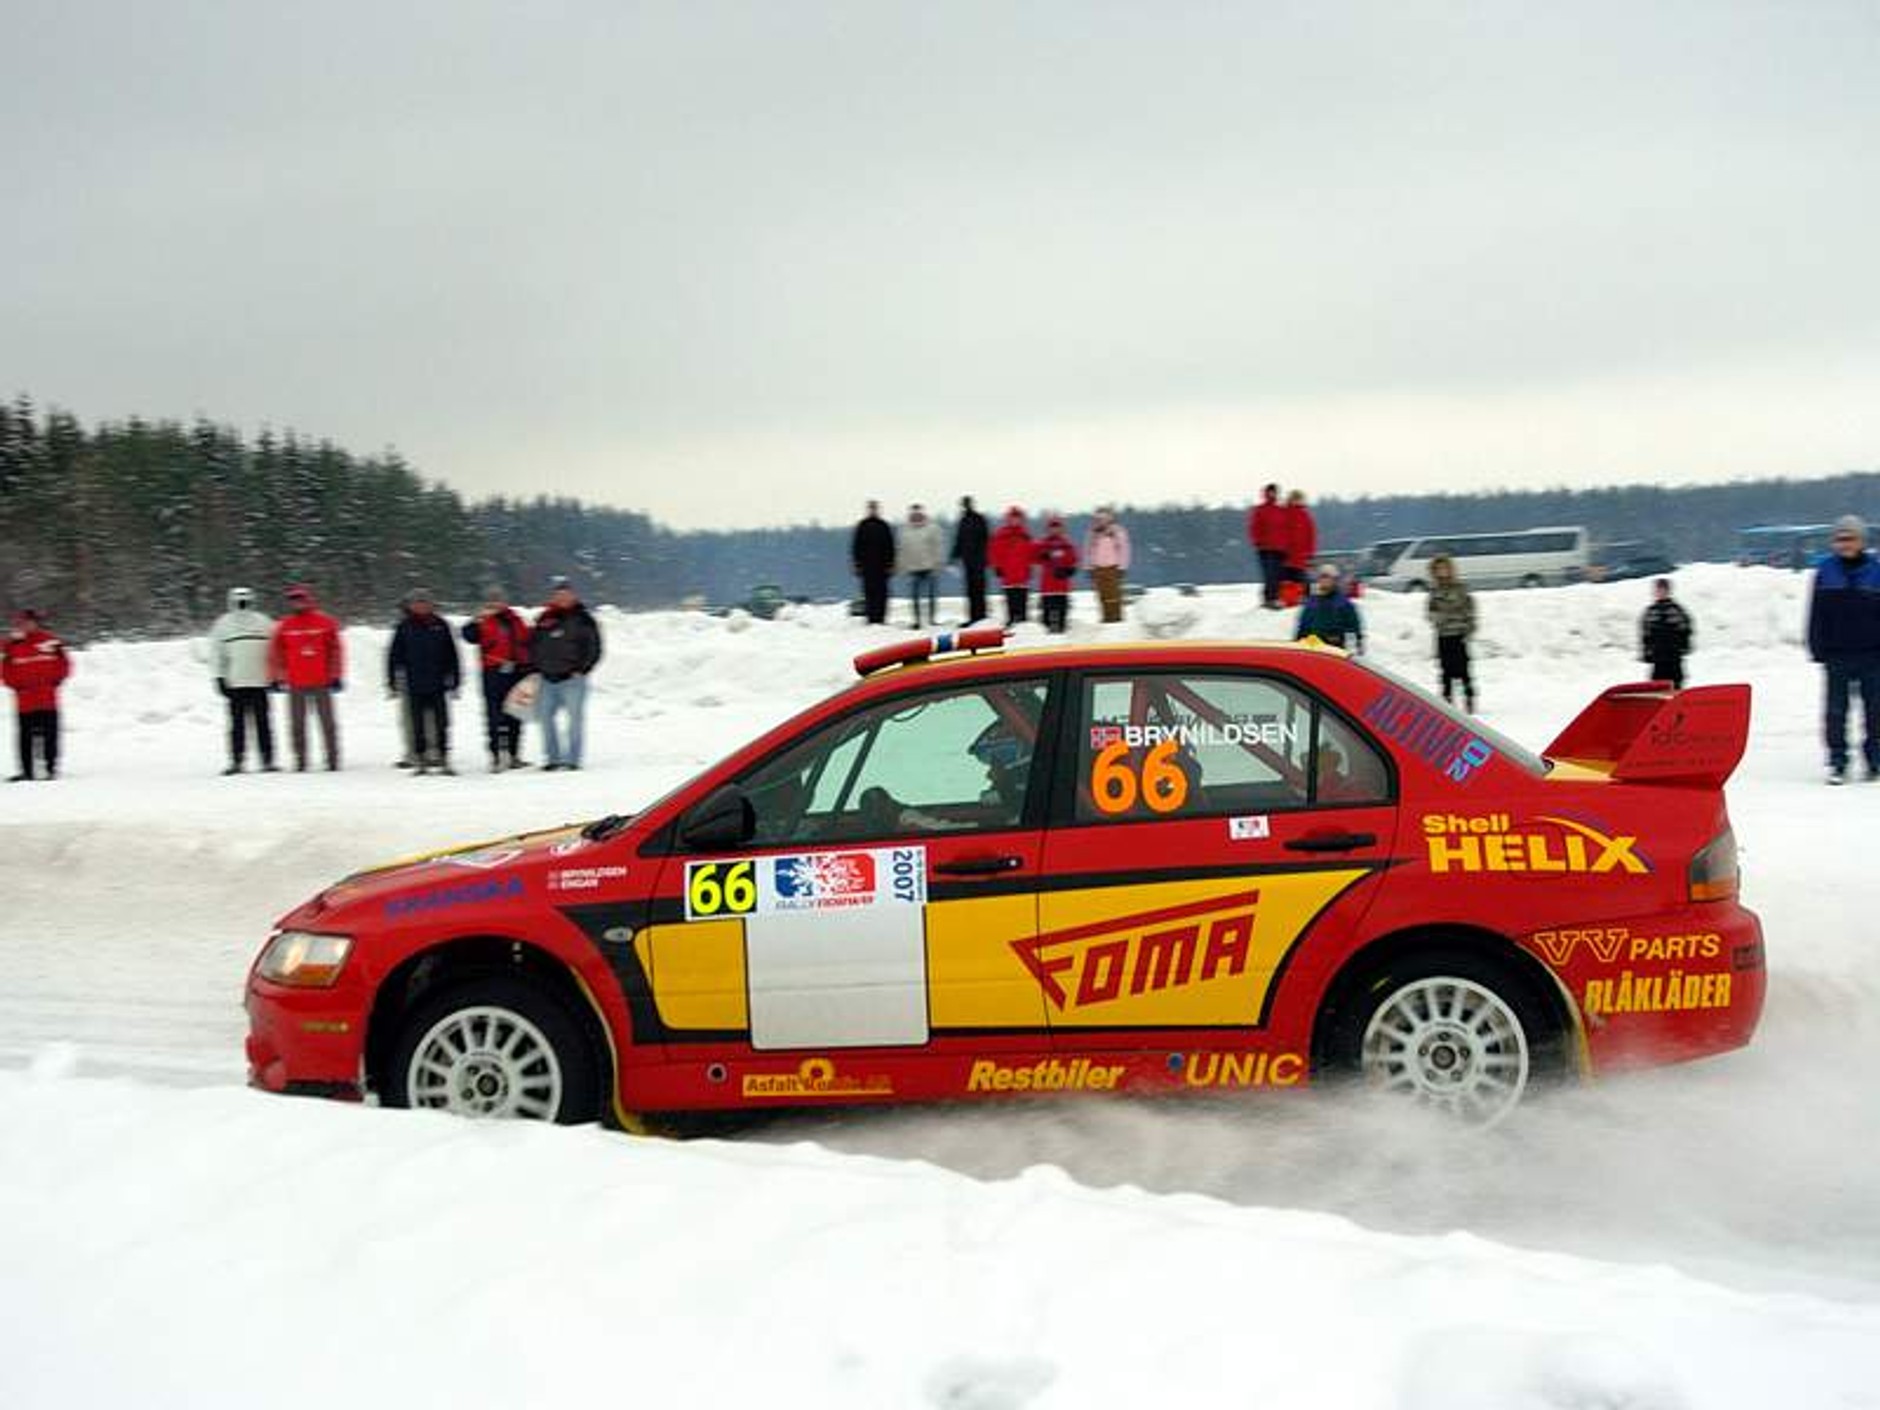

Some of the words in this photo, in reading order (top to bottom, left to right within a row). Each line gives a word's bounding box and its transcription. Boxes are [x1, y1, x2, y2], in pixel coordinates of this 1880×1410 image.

[1125, 722, 1299, 746] BRYNILDSEN
[1091, 738, 1189, 814] 66
[1422, 813, 1510, 834] Shell
[1426, 833, 1650, 873] HELIX
[690, 861, 757, 915] 66
[893, 850, 914, 903] 2007
[1008, 888, 1260, 1013] FOMA
[1630, 934, 1721, 961] PARTS
[1584, 969, 1732, 1016] BLÅKLÄDER
[746, 1076, 801, 1093] Asfalt
[968, 1059, 1126, 1092] Restbiler
[1186, 1053, 1303, 1087] UNIC
